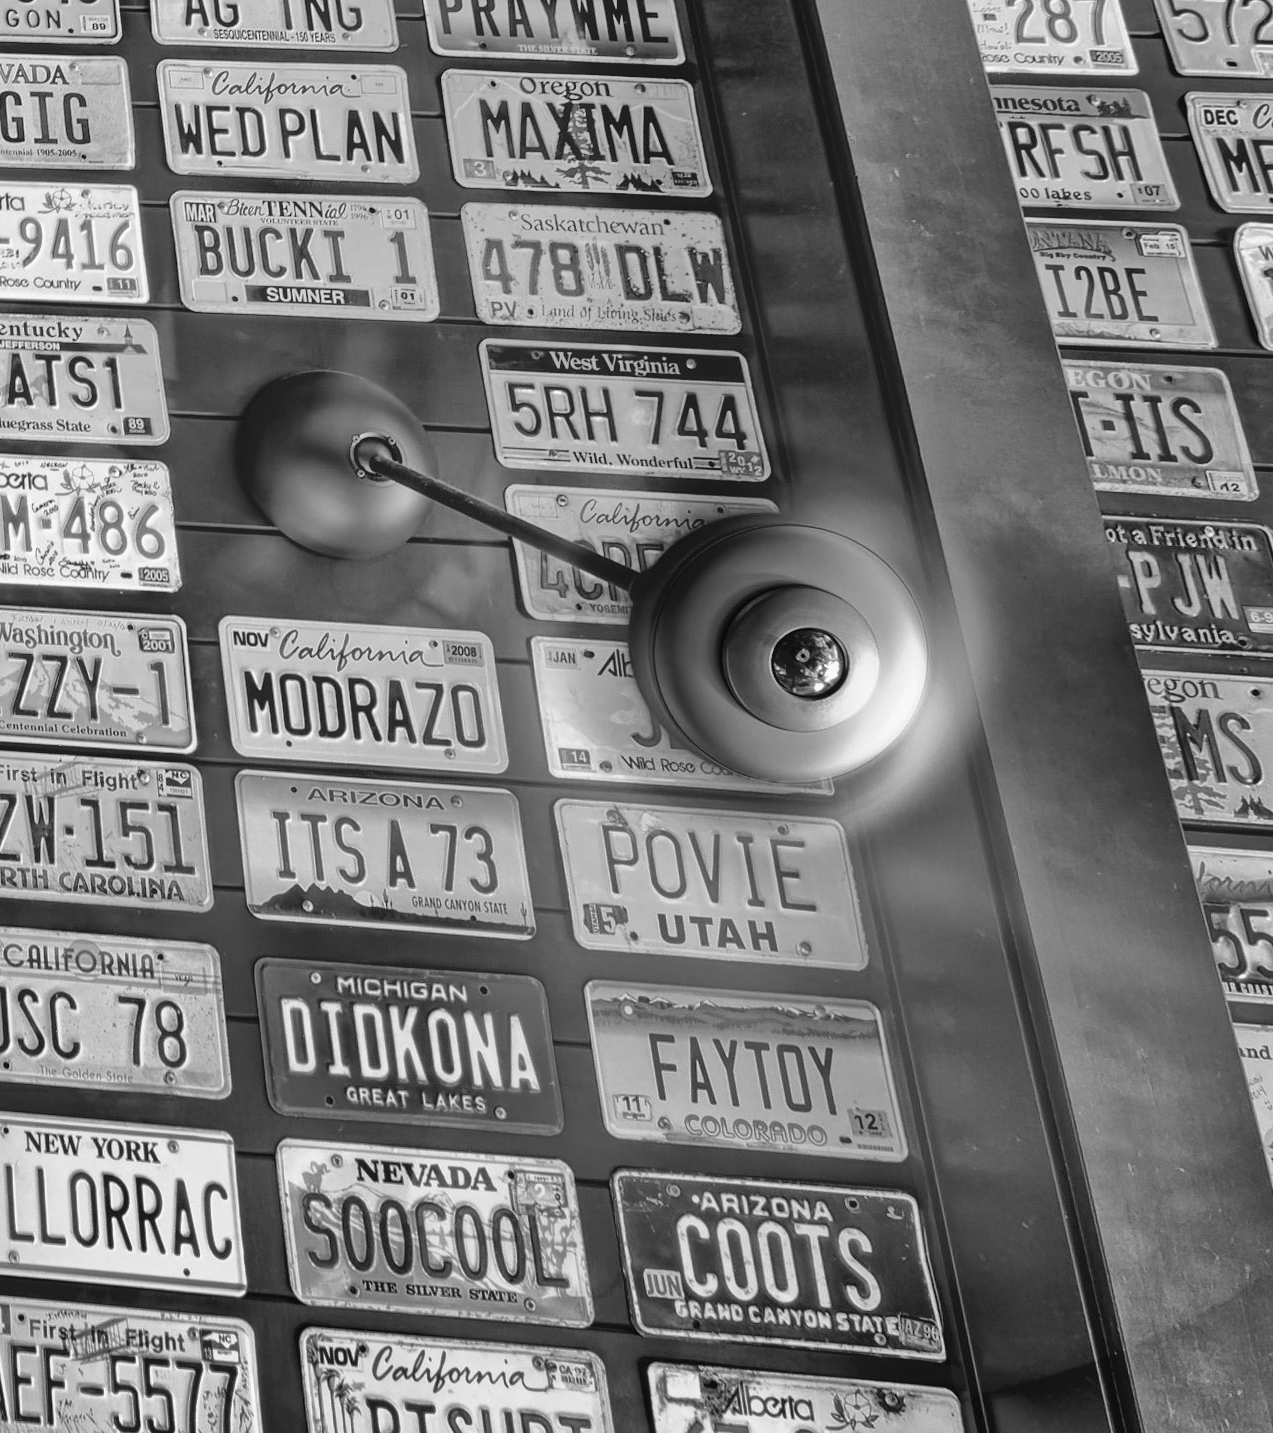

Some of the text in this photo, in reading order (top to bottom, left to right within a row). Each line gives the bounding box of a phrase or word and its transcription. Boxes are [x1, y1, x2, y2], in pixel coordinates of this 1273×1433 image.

[0, 91, 91, 146] GIG
[175, 107, 405, 165] WED PLAN
[479, 102, 676, 165] MAXIMA
[194, 228, 353, 288] BUCKI
[265, 288, 346, 306] SUMNER
[508, 383, 745, 451] 5RH 744
[604, 824, 817, 911] POVIE
[658, 913, 778, 951] UTAH
[285, 998, 539, 1090] DIDKONA
[652, 1033, 837, 1116] FAYTOY
[6, 1170, 232, 1260] LLORRAC
[673, 1213, 883, 1311] COOTS
